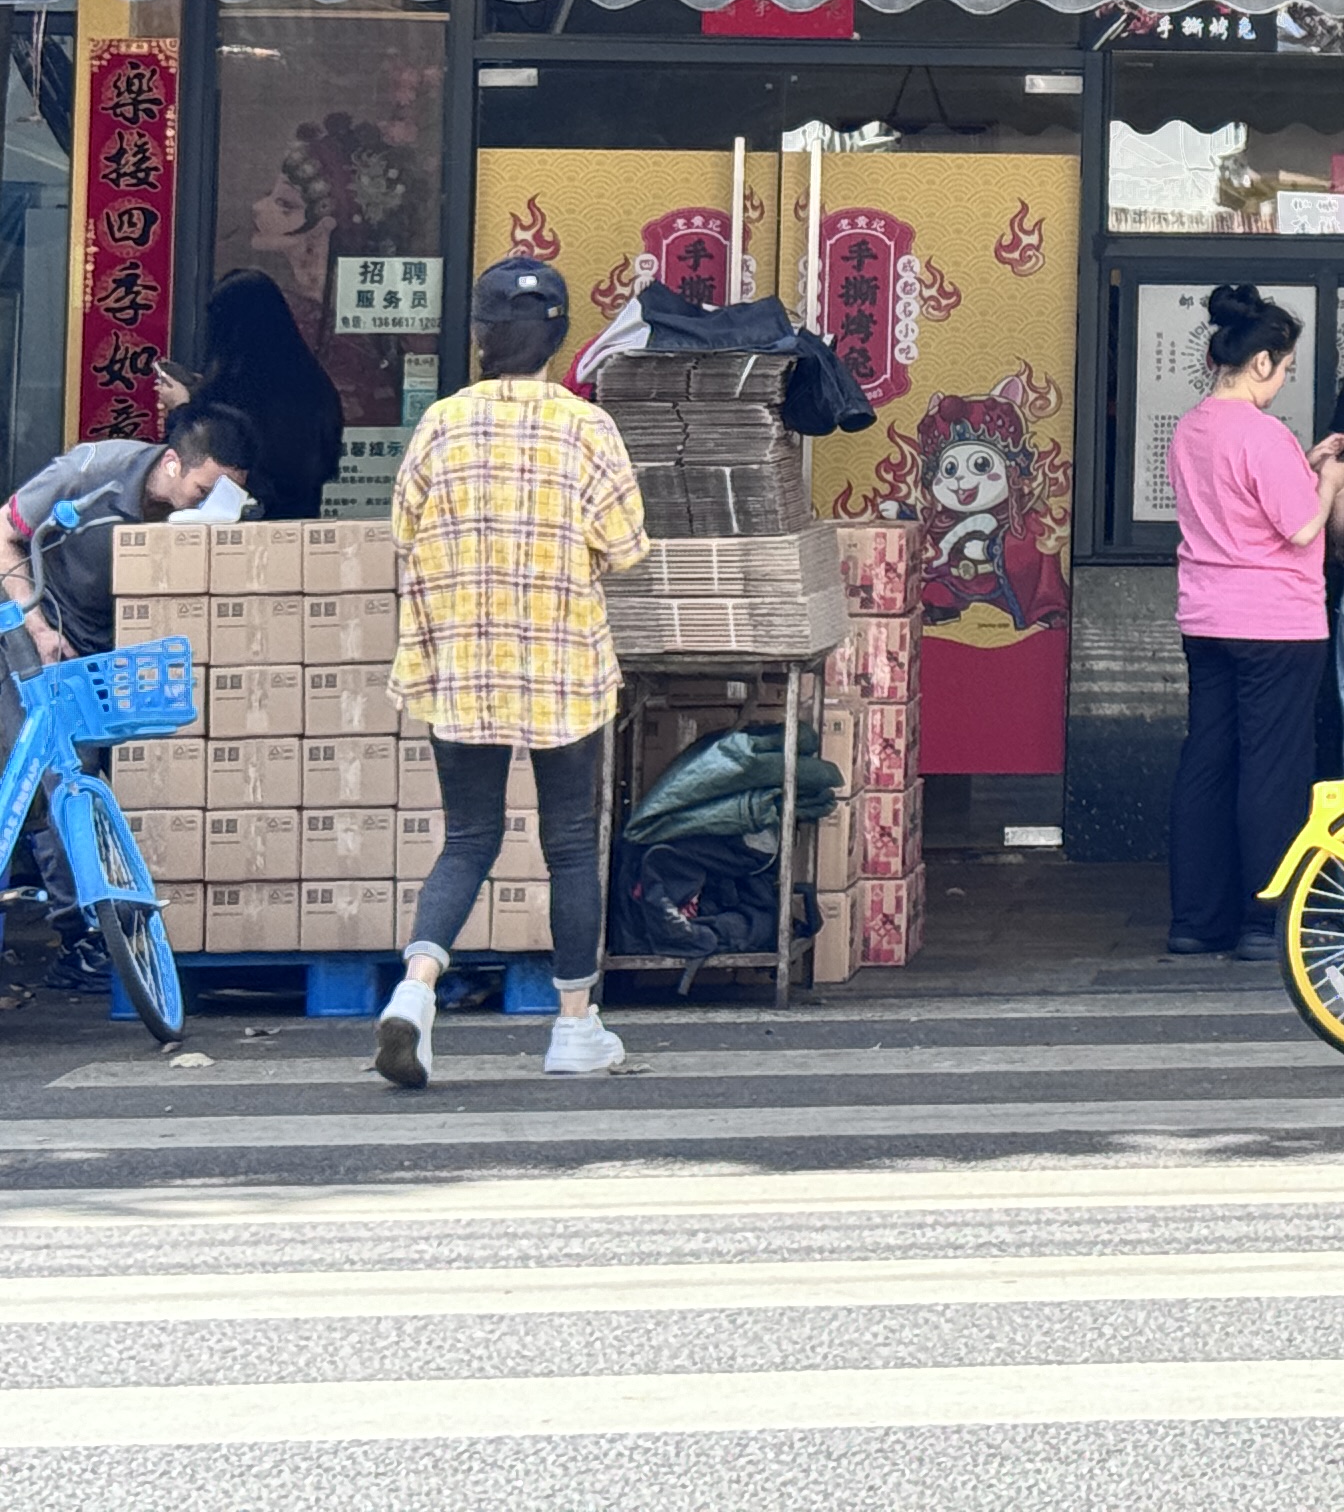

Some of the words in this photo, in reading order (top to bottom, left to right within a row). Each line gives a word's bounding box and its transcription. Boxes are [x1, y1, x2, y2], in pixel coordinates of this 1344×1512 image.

[359, 261, 428, 285] 招聘
[355, 290, 428, 309] 服务员
